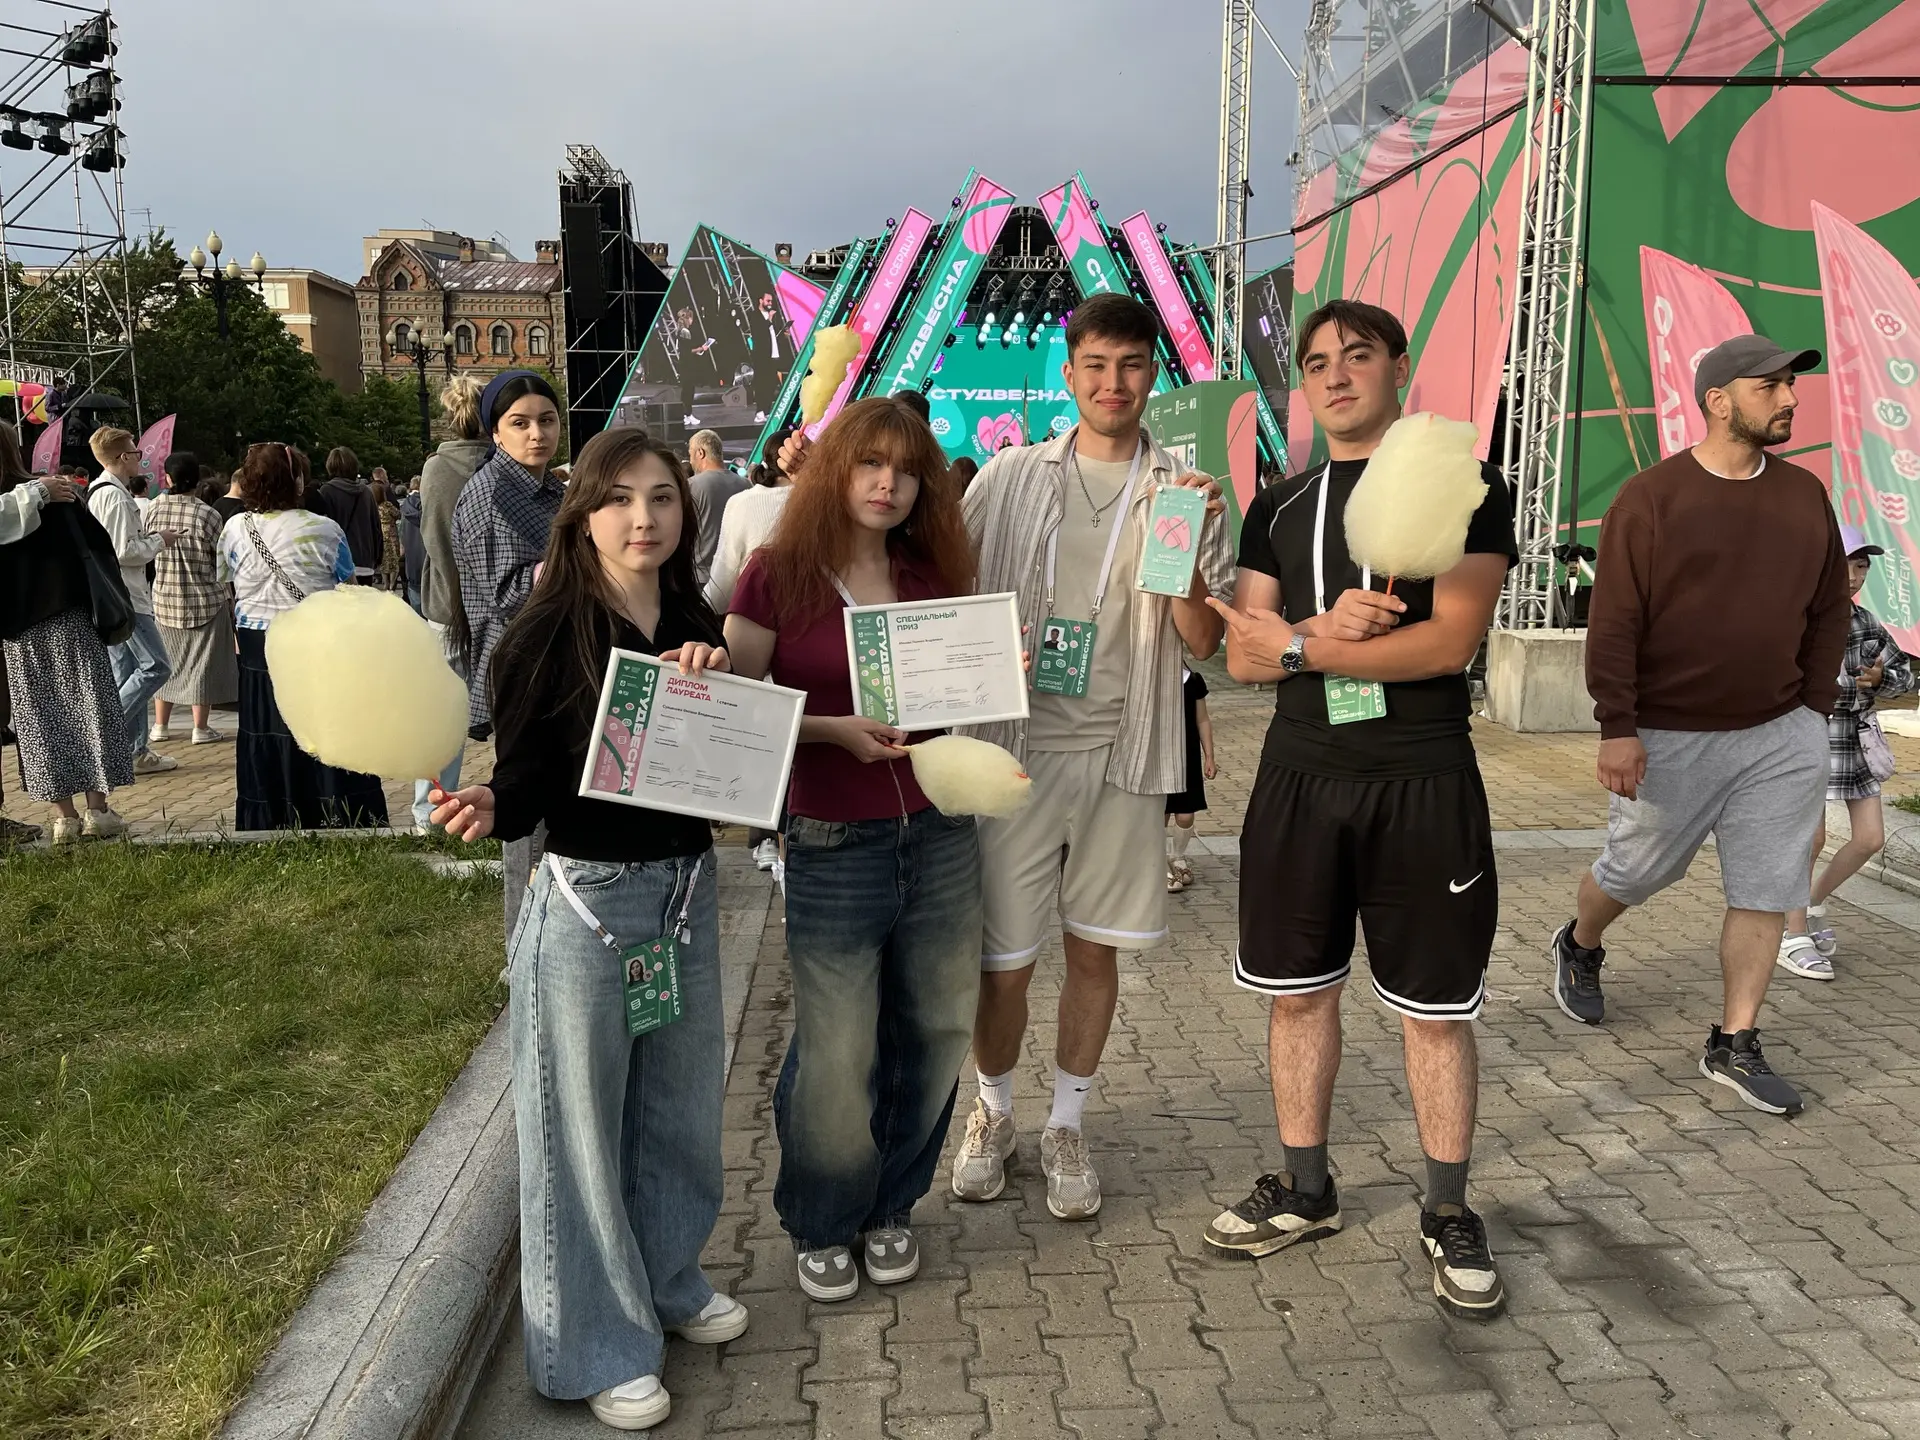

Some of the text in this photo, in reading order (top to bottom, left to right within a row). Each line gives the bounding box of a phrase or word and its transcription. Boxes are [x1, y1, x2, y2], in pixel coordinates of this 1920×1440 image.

[883, 230, 916, 290] К СЕРДЦУ
[1136, 231, 1168, 286] СЕРДЦЕМ
[774, 370, 802, 420] ХАБАРОВСК
[827, 283, 844, 309] ИЮНЯ
[886, 258, 969, 399] СТУДВЕСНА
[930, 388, 1072, 401] СТУДВЕСНА
[895, 610, 958, 624] СПЕЦИАЛЬНЫЙ
[896, 623, 919, 632] ПРИЗ
[667, 677, 709, 693] ДИПЛОМ
[875, 615, 896, 725] СТУДВЕСНА
[1076, 631, 1092, 694] СТУДВЕСНА
[665, 686, 712, 702] ЛАУРЕАТА
[620, 668, 656, 792] СТУДВЕСНА
[668, 944, 680, 1016] СТУДВЕСНА
